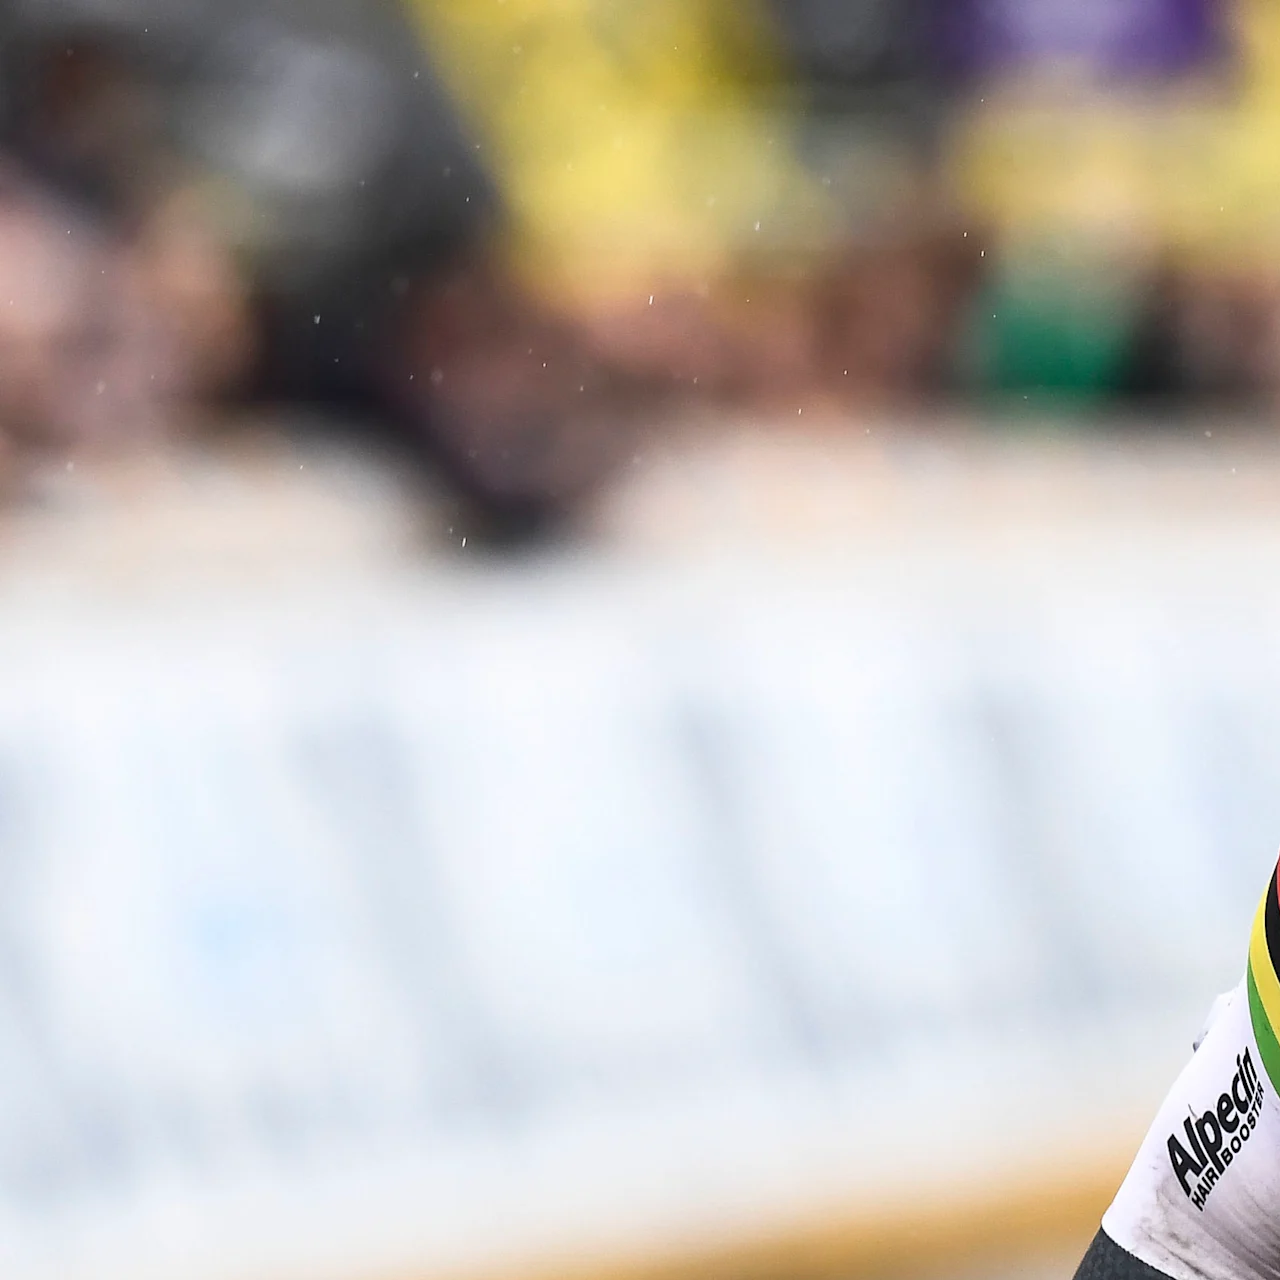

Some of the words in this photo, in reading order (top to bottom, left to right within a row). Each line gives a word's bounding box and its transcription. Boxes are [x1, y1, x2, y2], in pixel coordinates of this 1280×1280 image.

[1166, 1045, 1259, 1199] Alpecin
[1190, 1166, 1220, 1213] HAIR
[1220, 1080, 1265, 1168] BOOSTER
